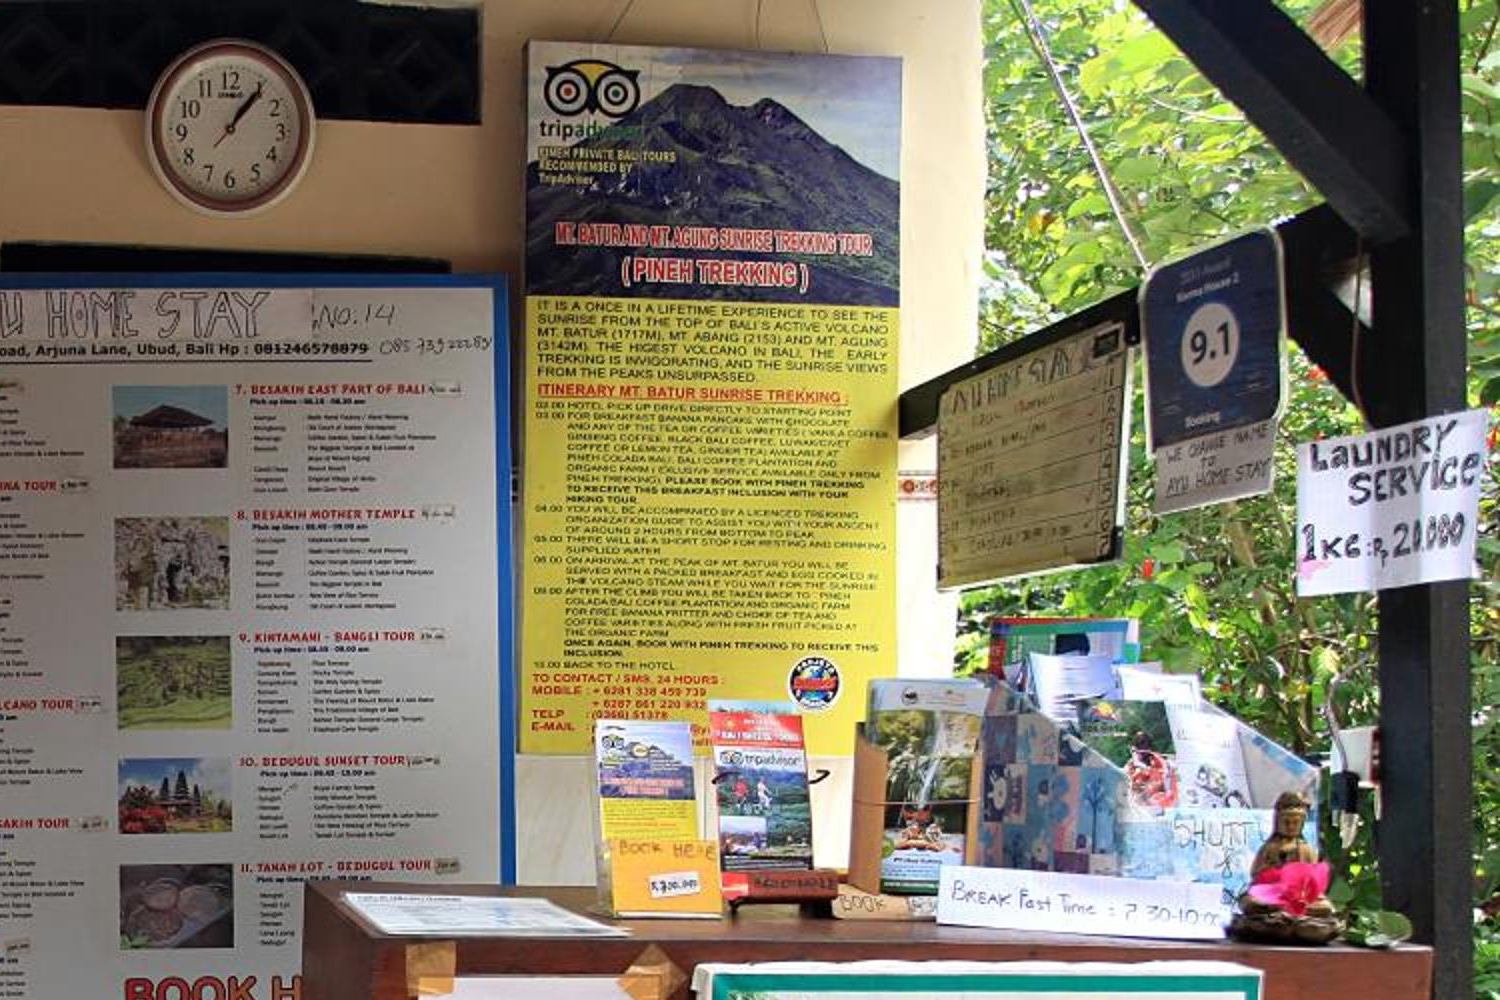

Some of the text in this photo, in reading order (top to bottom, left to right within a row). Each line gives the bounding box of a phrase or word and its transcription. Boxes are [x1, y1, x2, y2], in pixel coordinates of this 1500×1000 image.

[200, 80, 211, 97] 11
[222, 72, 240, 90] 12
[182, 100, 200, 118] 10
[270, 100, 280, 116] 2
[176, 124, 187, 141] 9
[276, 124, 285, 141] 3
[184, 148, 194, 165] 8
[266, 146, 277, 161] 4
[204, 166, 213, 182] 7
[224, 171, 235, 188] 6
[251, 164, 260, 181] 5
[674, 227, 717, 249] AGUNG
[720, 229, 772, 251] SUNRISE
[776, 231, 836, 254] TREKKING
[839, 234, 873, 256] TOUR
[46, 292, 139, 338] HOME
[156, 291, 271, 338] STAY
[36, 345, 86, 359] Arjuna
[92, 344, 131, 357] Lane,
[138, 343, 180, 357] Ubud,
[186, 343, 214, 355] Bali
[220, 343, 239, 356] Hp
[1190, 322, 1229, 366] 9.1
[538, 367, 576, 377] FROM
[580, 368, 605, 378] THE
[610, 369, 653, 379] PEAKS
[538, 384, 613, 396] ITINERARY
[650, 387, 695, 398] BATUR
[700, 389, 763, 400] SUNRISE
[769, 390, 841, 403] TREKKING
[42, 700, 74, 710] TOUR
[1060, 893, 1097, 914] Time
